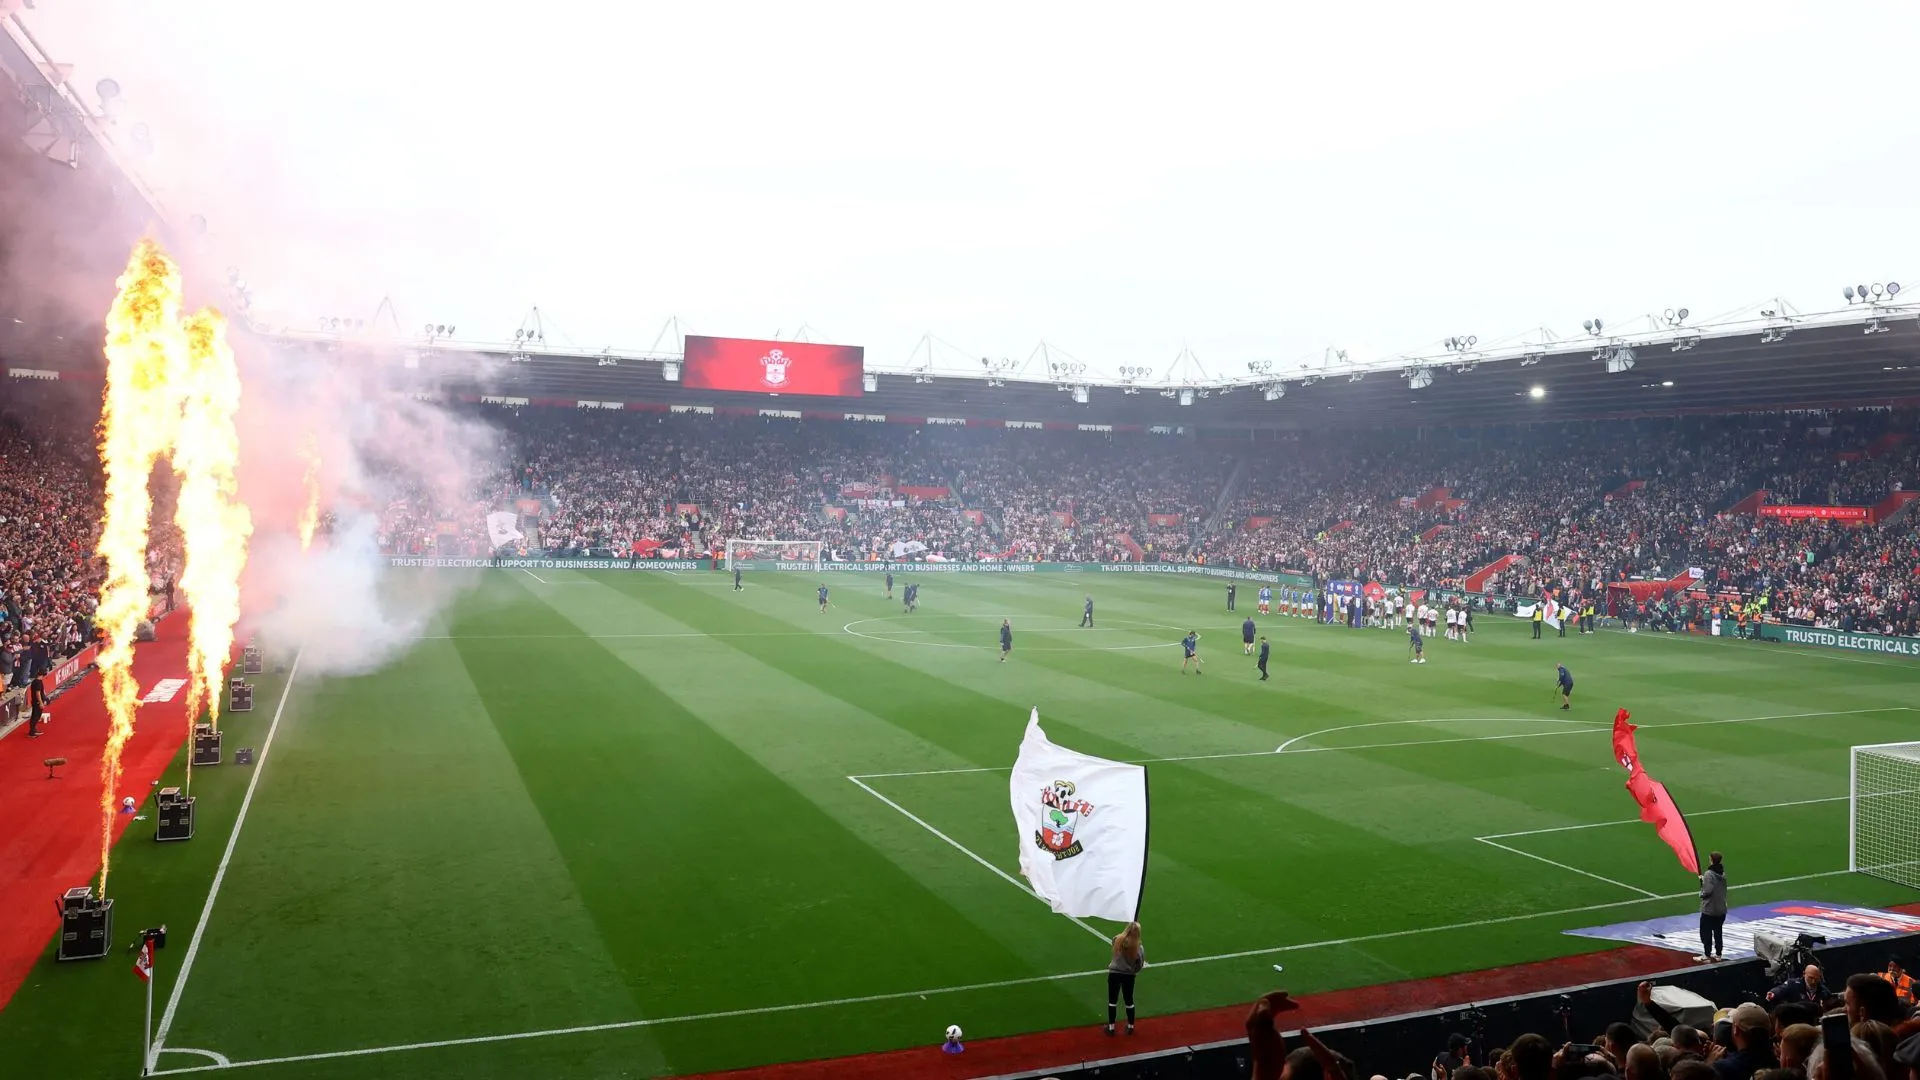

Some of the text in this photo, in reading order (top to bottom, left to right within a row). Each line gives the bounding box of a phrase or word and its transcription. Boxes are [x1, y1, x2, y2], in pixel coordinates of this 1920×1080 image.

[391, 558, 436, 567] TRUSTED
[438, 559, 493, 568] ELECTRICAL
[495, 559, 539, 568] SUPPORT
[541, 560, 553, 568] TO
[555, 560, 609, 569] BUSINESSES
[610, 560, 632, 569] AND
[776, 562, 813, 571] TRUSTED
[864, 563, 901, 571] SUPPORT
[902, 563, 913, 572] TO
[915, 563, 960, 572] BUSINESSES
[962, 563, 978, 572] AND
[1101, 564, 1132, 572] TRUSTED
[1133, 564, 1176, 573] ELECTRICAL
[1177, 565, 1204, 574] SUPPORT
[1211, 567, 1234, 577] BUSINESSES
[1235, 570, 1244, 579] AND
[1245, 571, 1279, 583] HOMEOWNERS
[1785, 629, 1836, 646] TRUSTED
[1837, 635, 1910, 654] ELECTRICAL
